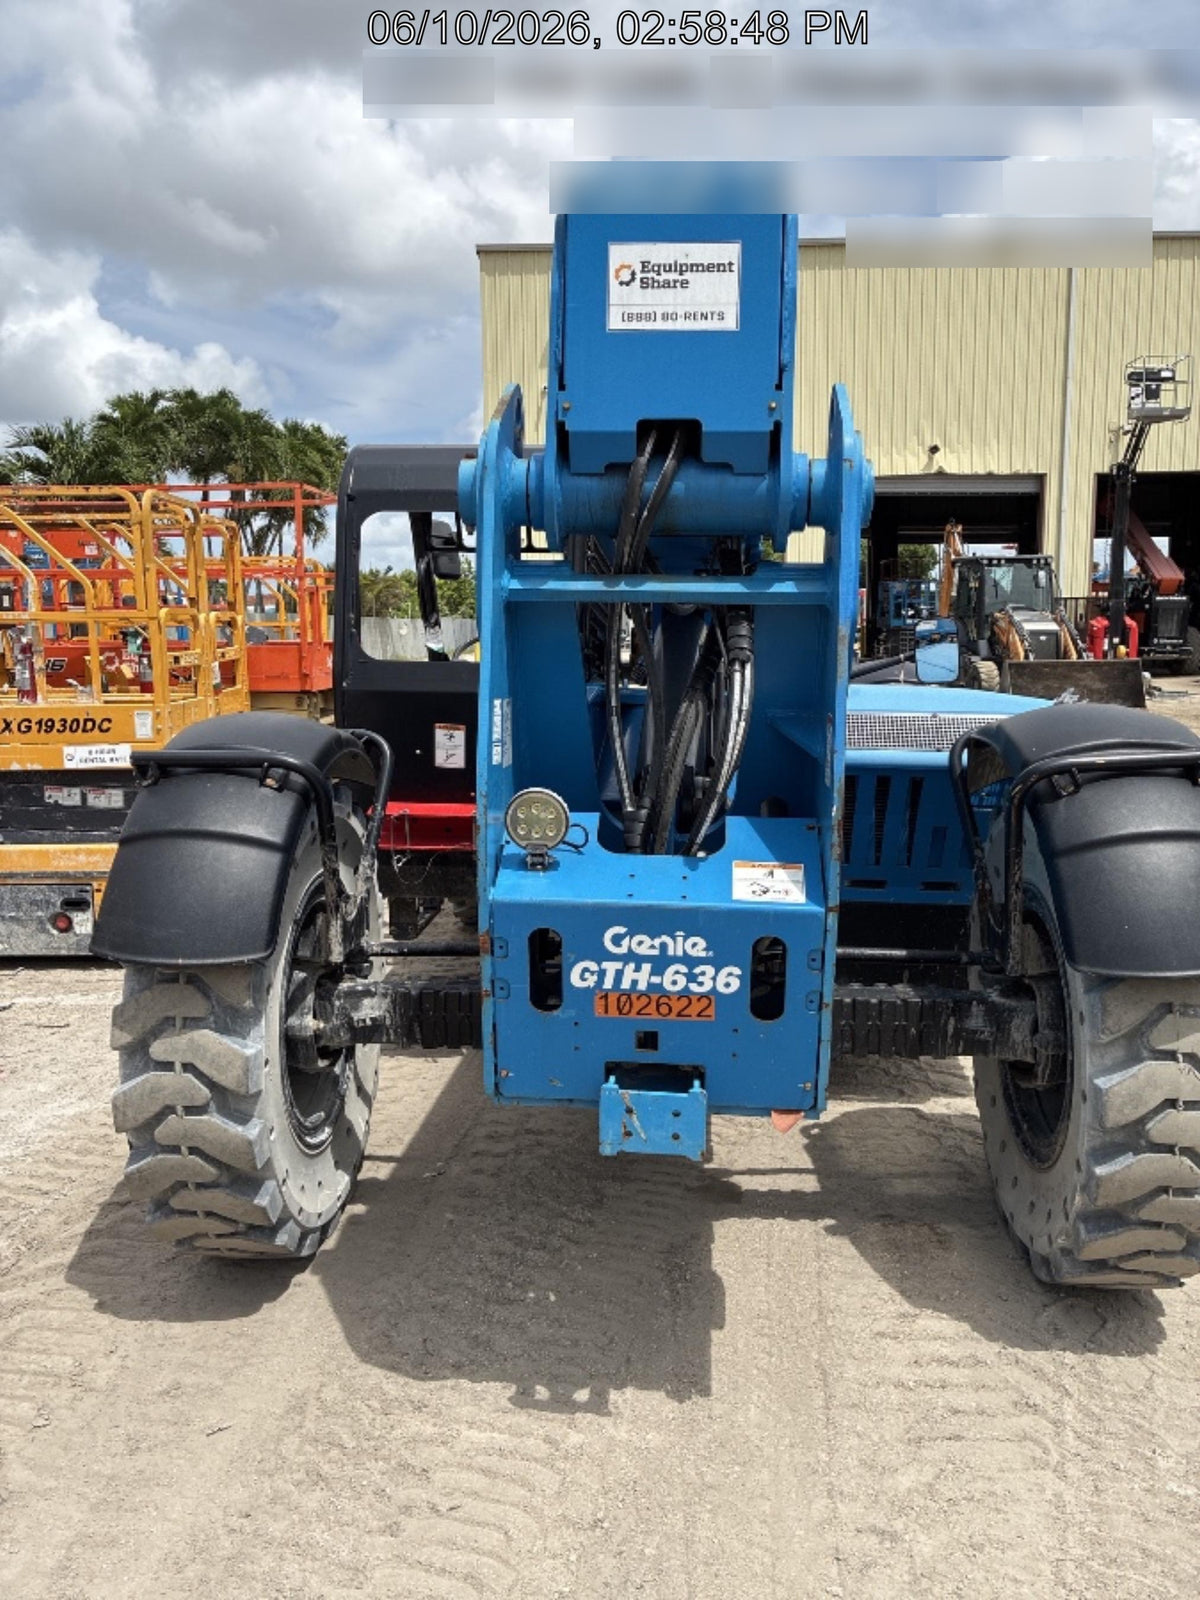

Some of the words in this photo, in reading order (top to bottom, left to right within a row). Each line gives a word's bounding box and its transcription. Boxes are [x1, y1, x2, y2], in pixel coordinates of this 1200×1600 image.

[640, 260, 735, 276] Equipment
[640, 277, 690, 289] Share
[0, 717, 113, 735] XG1930DC
[603, 925, 708, 957] Genie
[570, 960, 743, 994] GTH-636
[597, 992, 713, 1018] 102622
